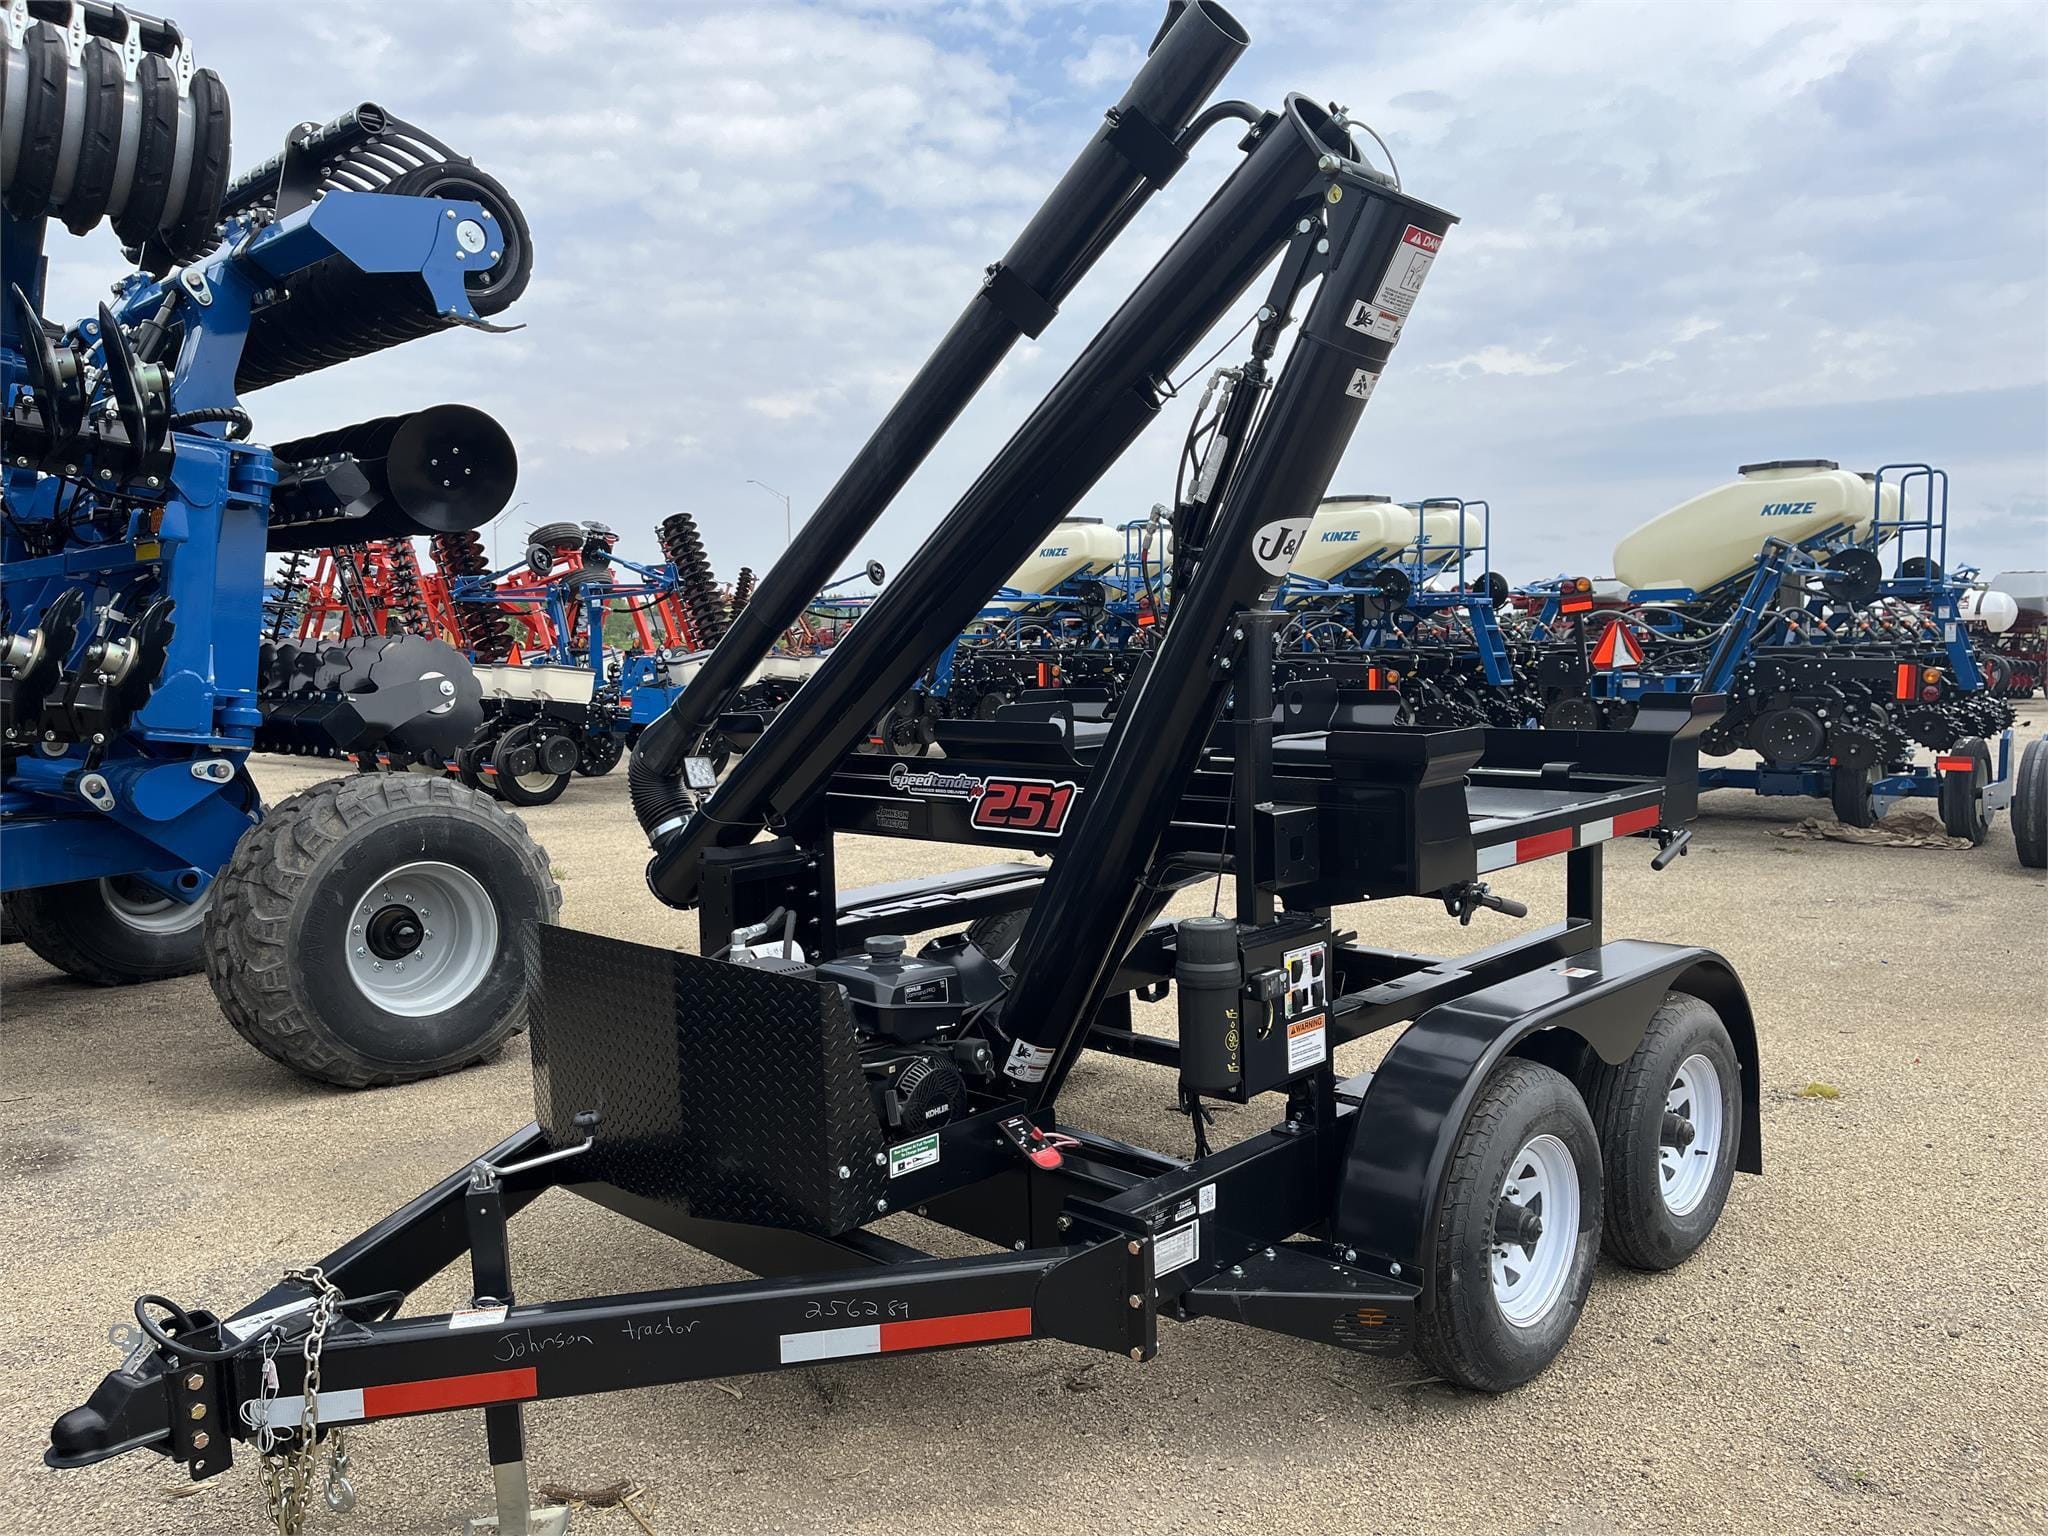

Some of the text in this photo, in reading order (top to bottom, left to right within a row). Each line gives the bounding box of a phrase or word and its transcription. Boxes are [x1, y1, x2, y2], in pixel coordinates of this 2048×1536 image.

[1760, 502, 1817, 516] KINZE
[1321, 530, 1361, 542] KINZE
[1039, 547, 1069, 558] KINZE
[976, 783, 1071, 830] 251
[1295, 1017, 1323, 1033] WARNING
[925, 1104, 950, 1119] KOHLER
[805, 1299, 909, 1319] 256289
[493, 1316, 701, 1362] Johnson tractor
